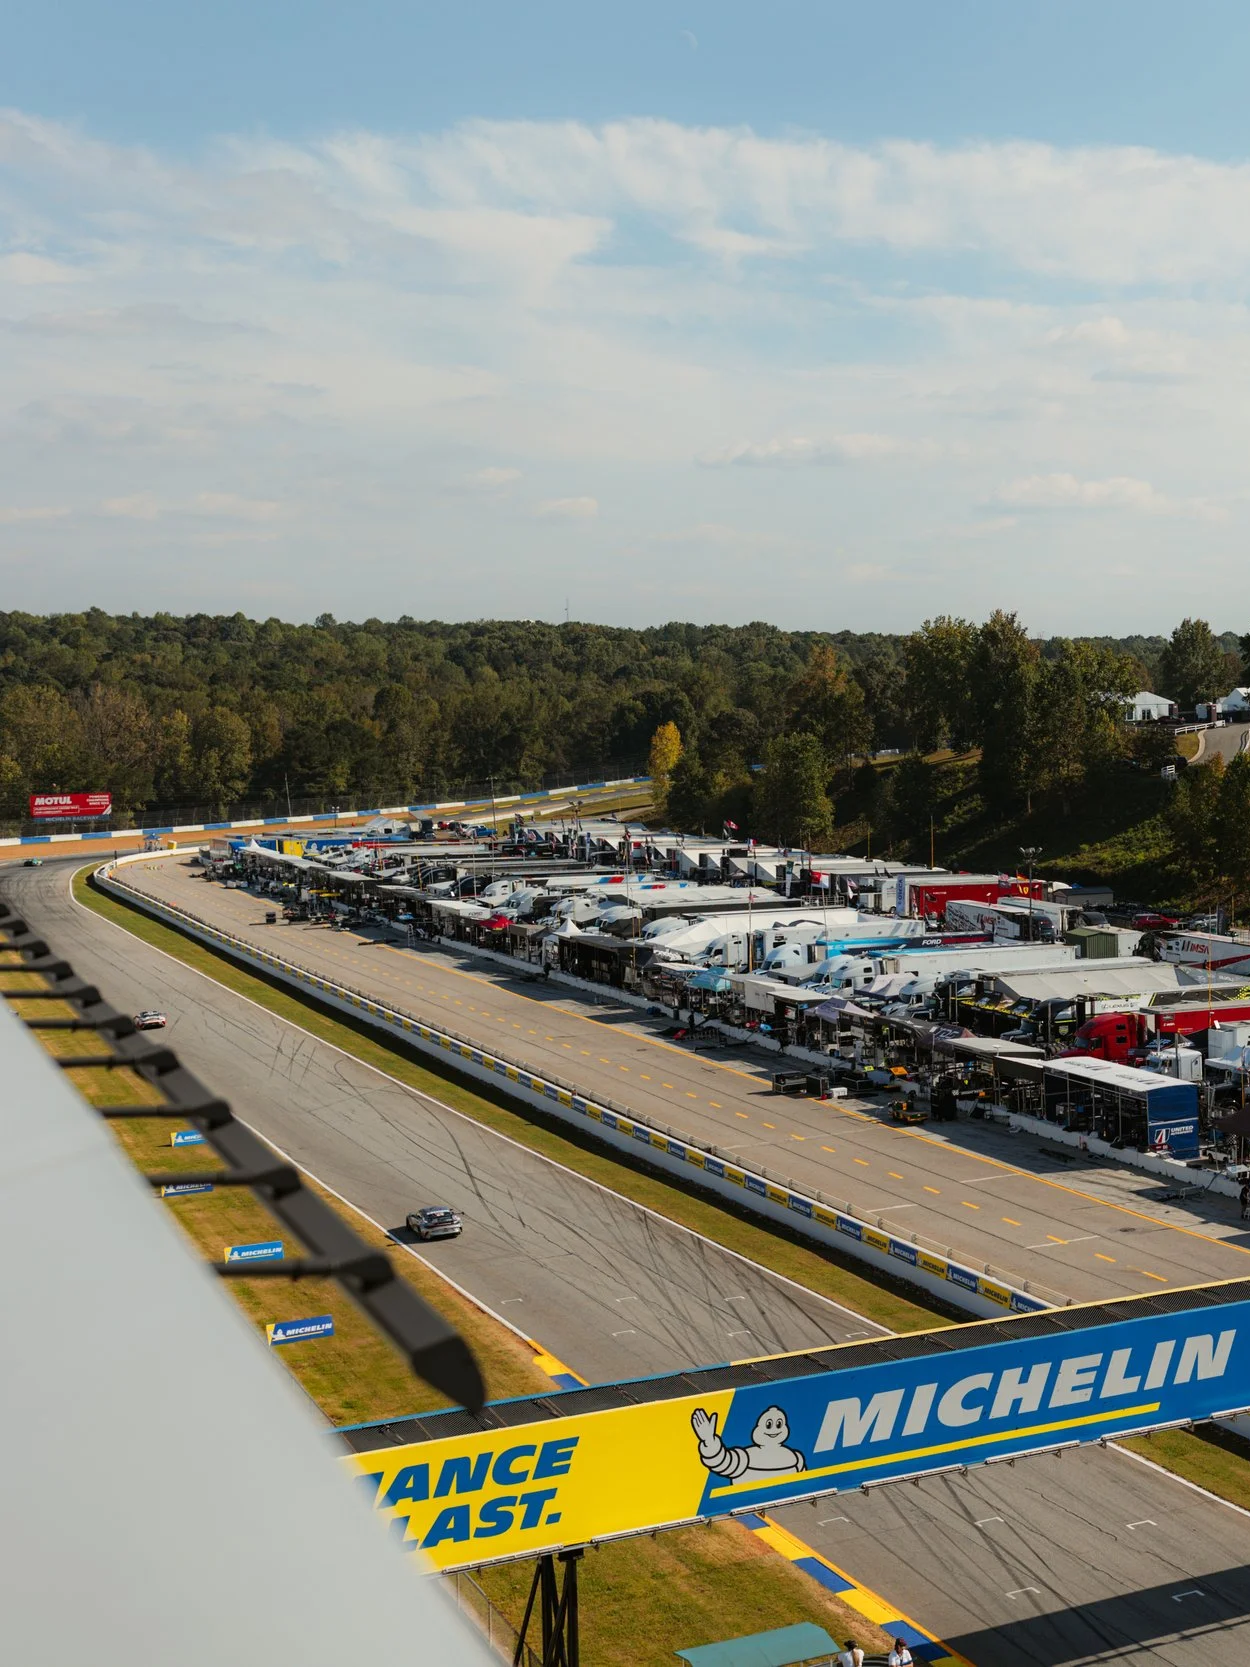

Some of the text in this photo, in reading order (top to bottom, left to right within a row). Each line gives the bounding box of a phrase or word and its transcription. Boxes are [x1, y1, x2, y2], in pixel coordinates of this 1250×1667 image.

[34, 796, 72, 806] MOTUL
[1171, 1125, 1194, 1133] UNITED
[240, 1247, 283, 1258] MICHELIN
[922, 1258, 945, 1274] MICHELIN
[952, 1272, 977, 1289] MICHELIN
[984, 1287, 1009, 1303] MICHELIN
[285, 1322, 333, 1336] MICHELIN
[813, 1329, 1237, 1454] MICHELIN
